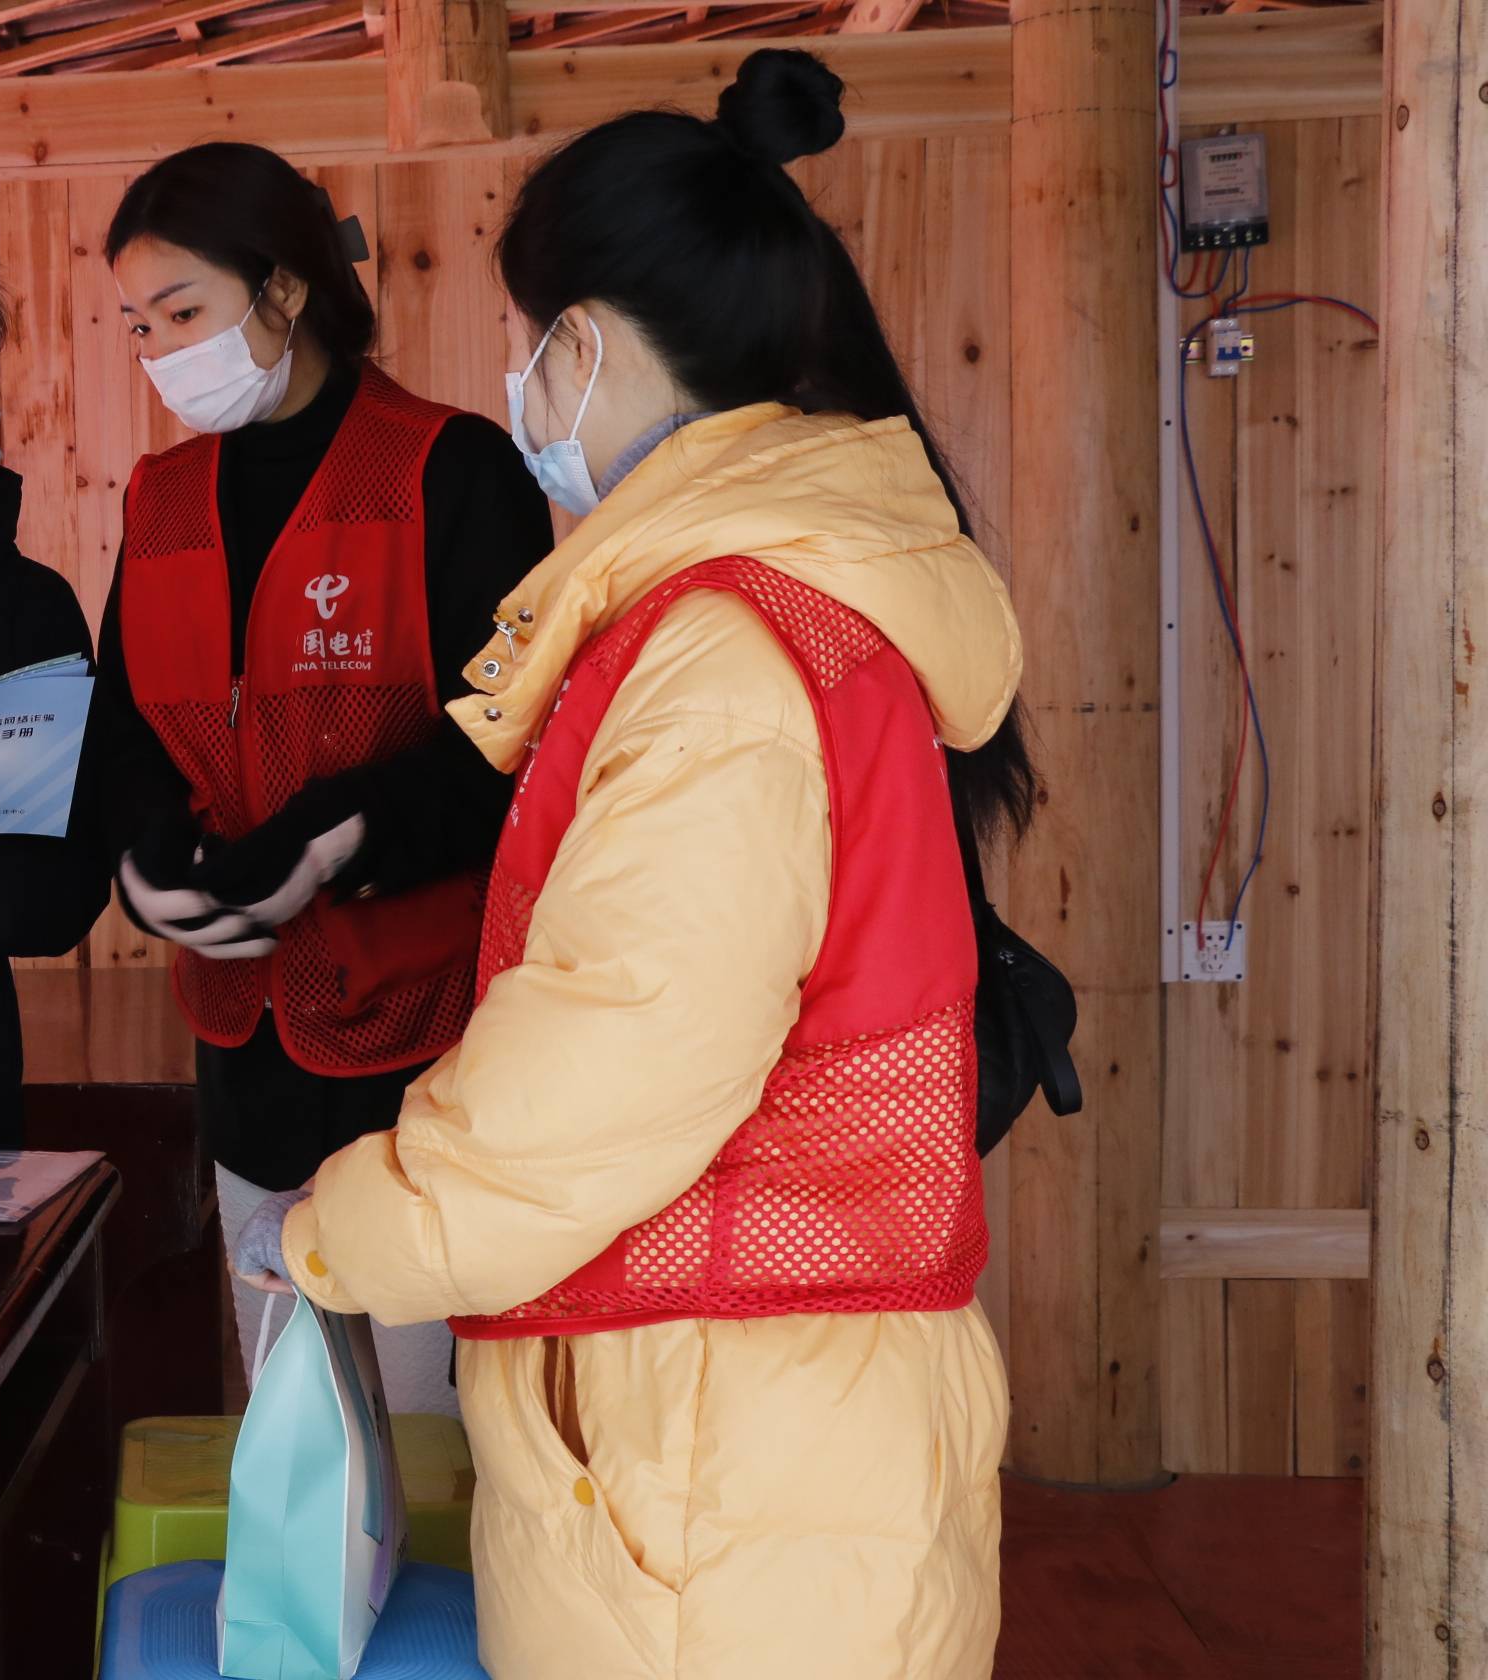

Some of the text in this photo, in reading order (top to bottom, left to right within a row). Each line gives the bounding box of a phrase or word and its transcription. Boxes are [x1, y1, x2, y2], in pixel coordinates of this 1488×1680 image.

[297, 628, 373, 658] 国电信
[320, 660, 371, 671] TELECOM
